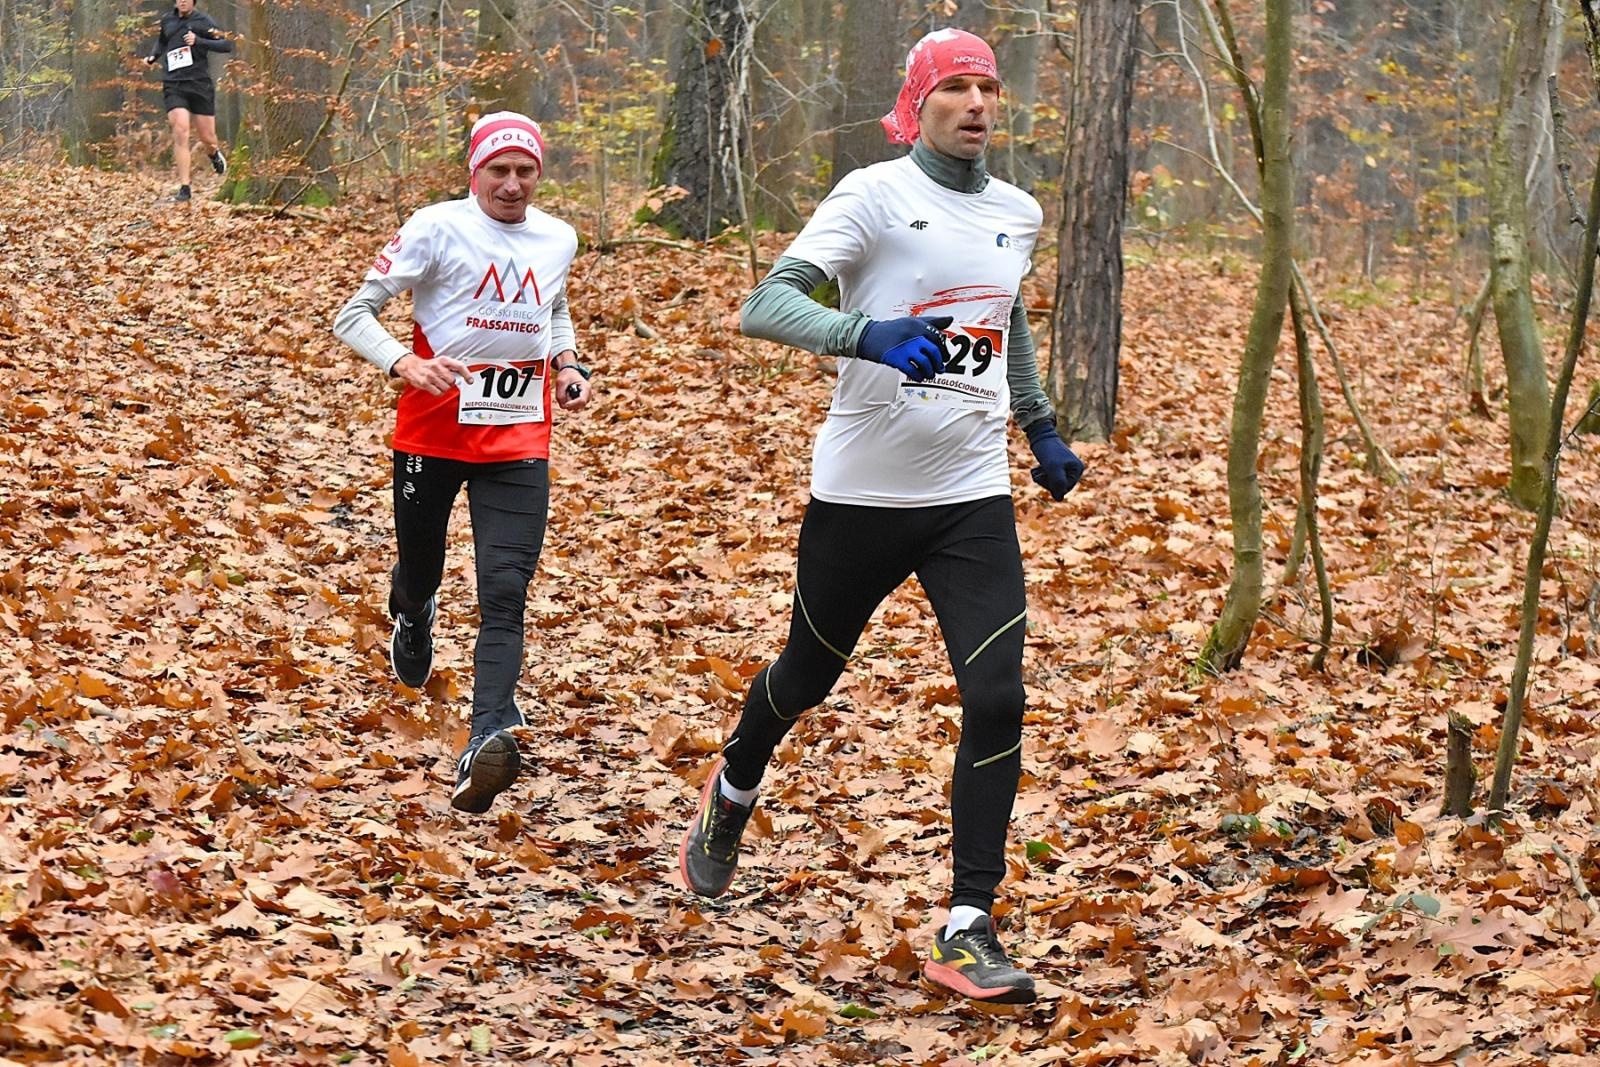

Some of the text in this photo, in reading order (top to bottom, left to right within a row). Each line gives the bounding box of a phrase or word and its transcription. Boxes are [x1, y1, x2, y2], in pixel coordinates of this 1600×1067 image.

[910, 220, 929, 230] 4F
[513, 310, 533, 320] BIEG
[466, 317, 540, 334] FRASSATIEGO
[942, 334, 993, 377] 29
[480, 366, 536, 399] 107
